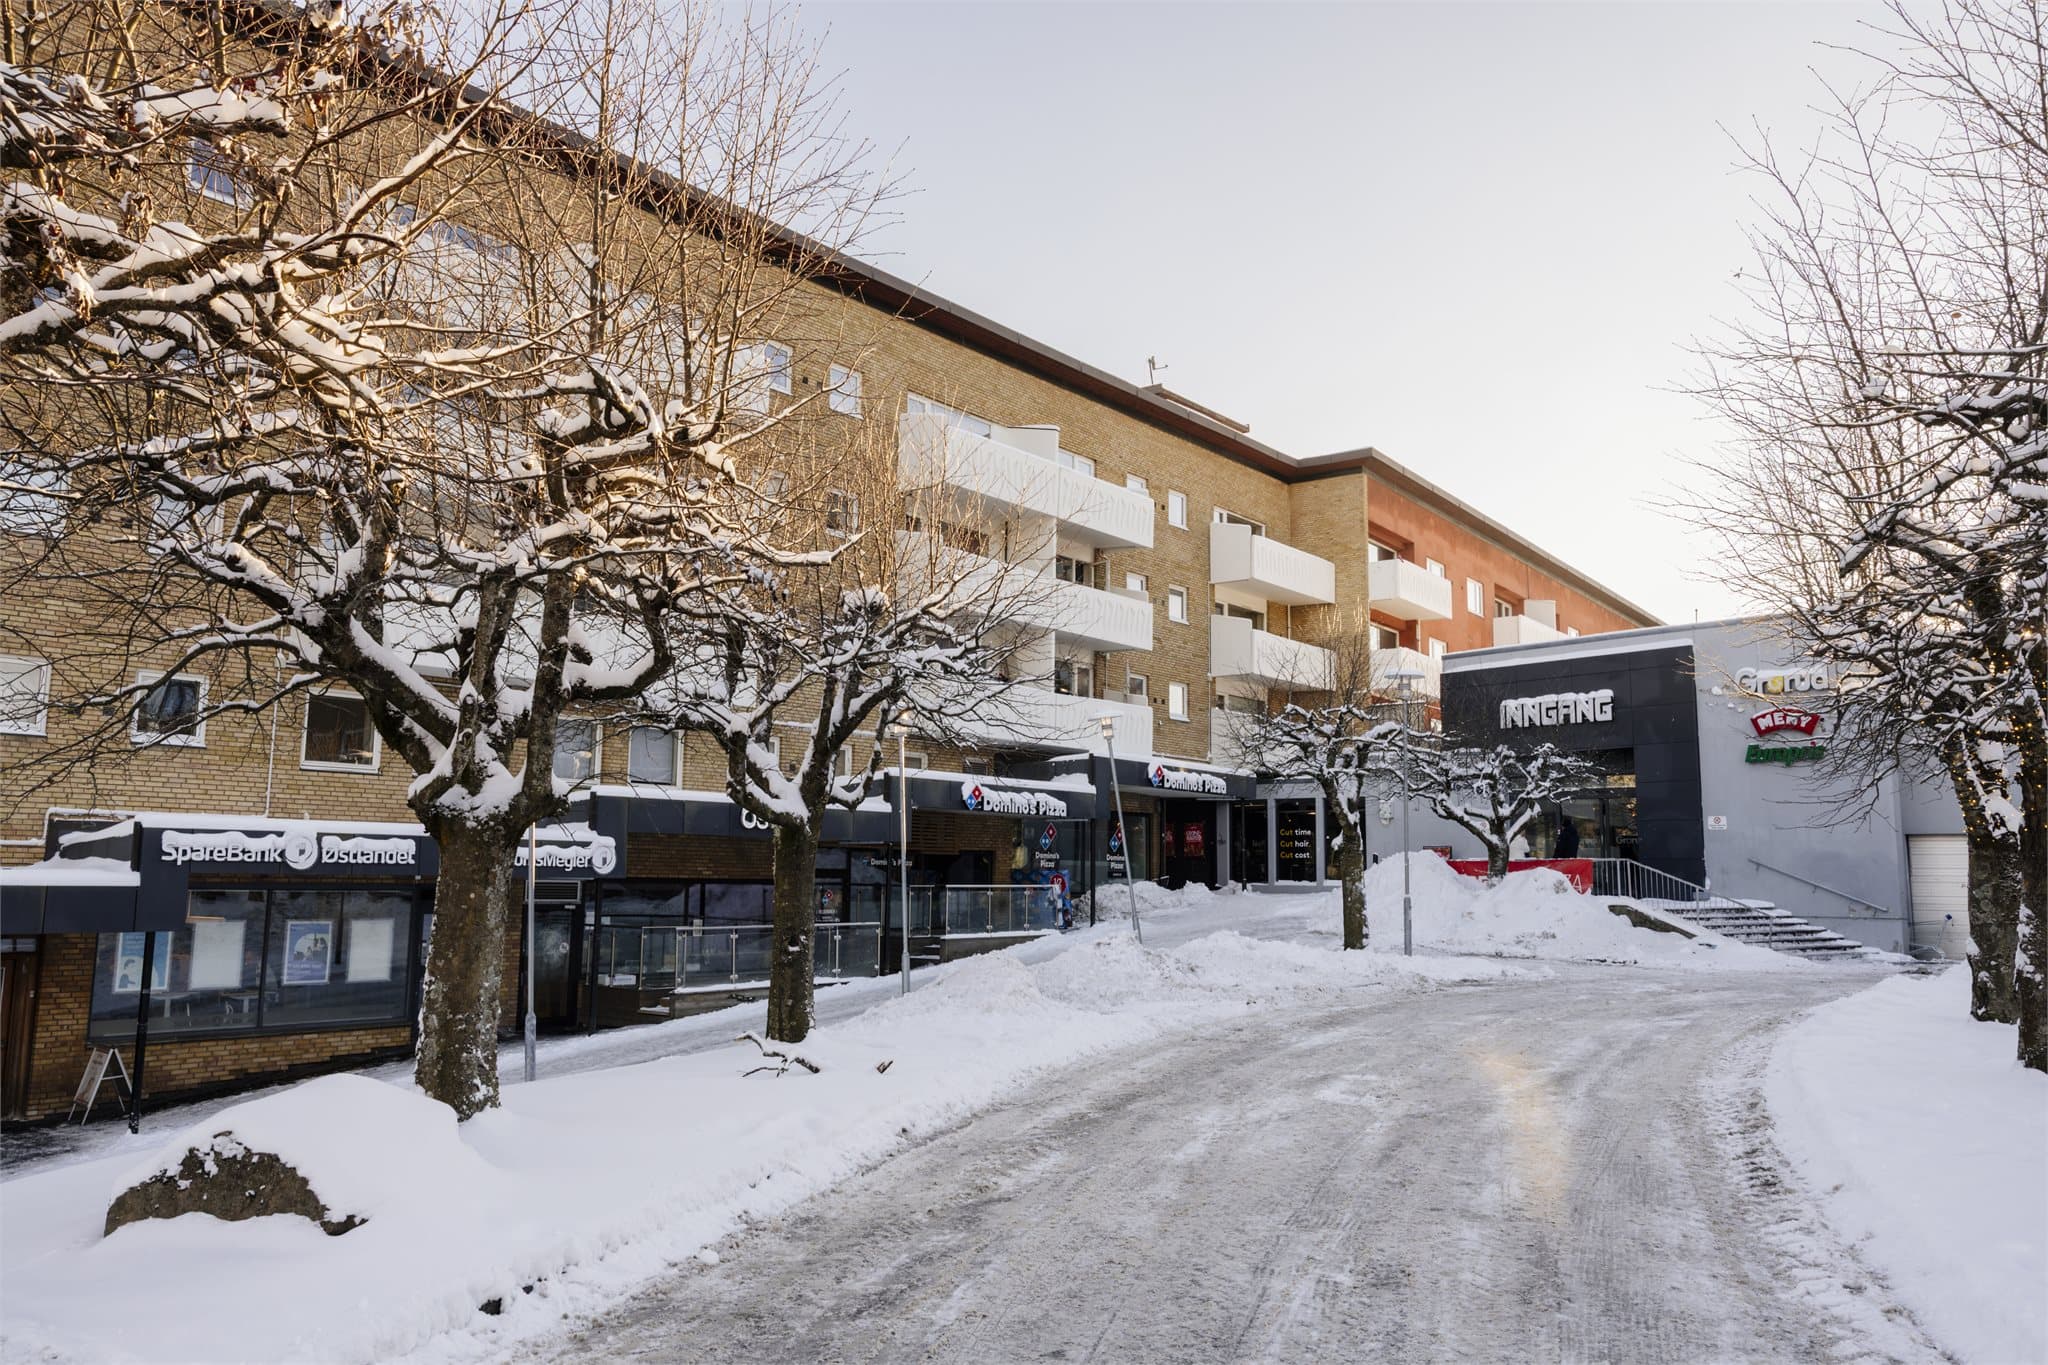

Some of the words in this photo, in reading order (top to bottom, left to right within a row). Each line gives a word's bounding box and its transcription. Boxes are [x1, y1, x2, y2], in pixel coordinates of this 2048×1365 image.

[1500, 693, 1614, 729] INNGANG
[1756, 711, 1813, 731] MENY
[1163, 773, 1203, 792] Domino's
[1204, 777, 1227, 795] Pizza
[983, 796, 1037, 816] Domino's
[1038, 799, 1067, 817] Pizza
[1280, 828, 1293, 836] Cut
[1280, 840, 1293, 848] Cut
[161, 838, 283, 865] SpareBank
[321, 841, 416, 865] Østlandet
[1035, 851, 1059, 860] Domino's
[1280, 851, 1293, 859] Cut
[1040, 860, 1055, 868] Pizza
[1110, 862, 1124, 870] Pizza
